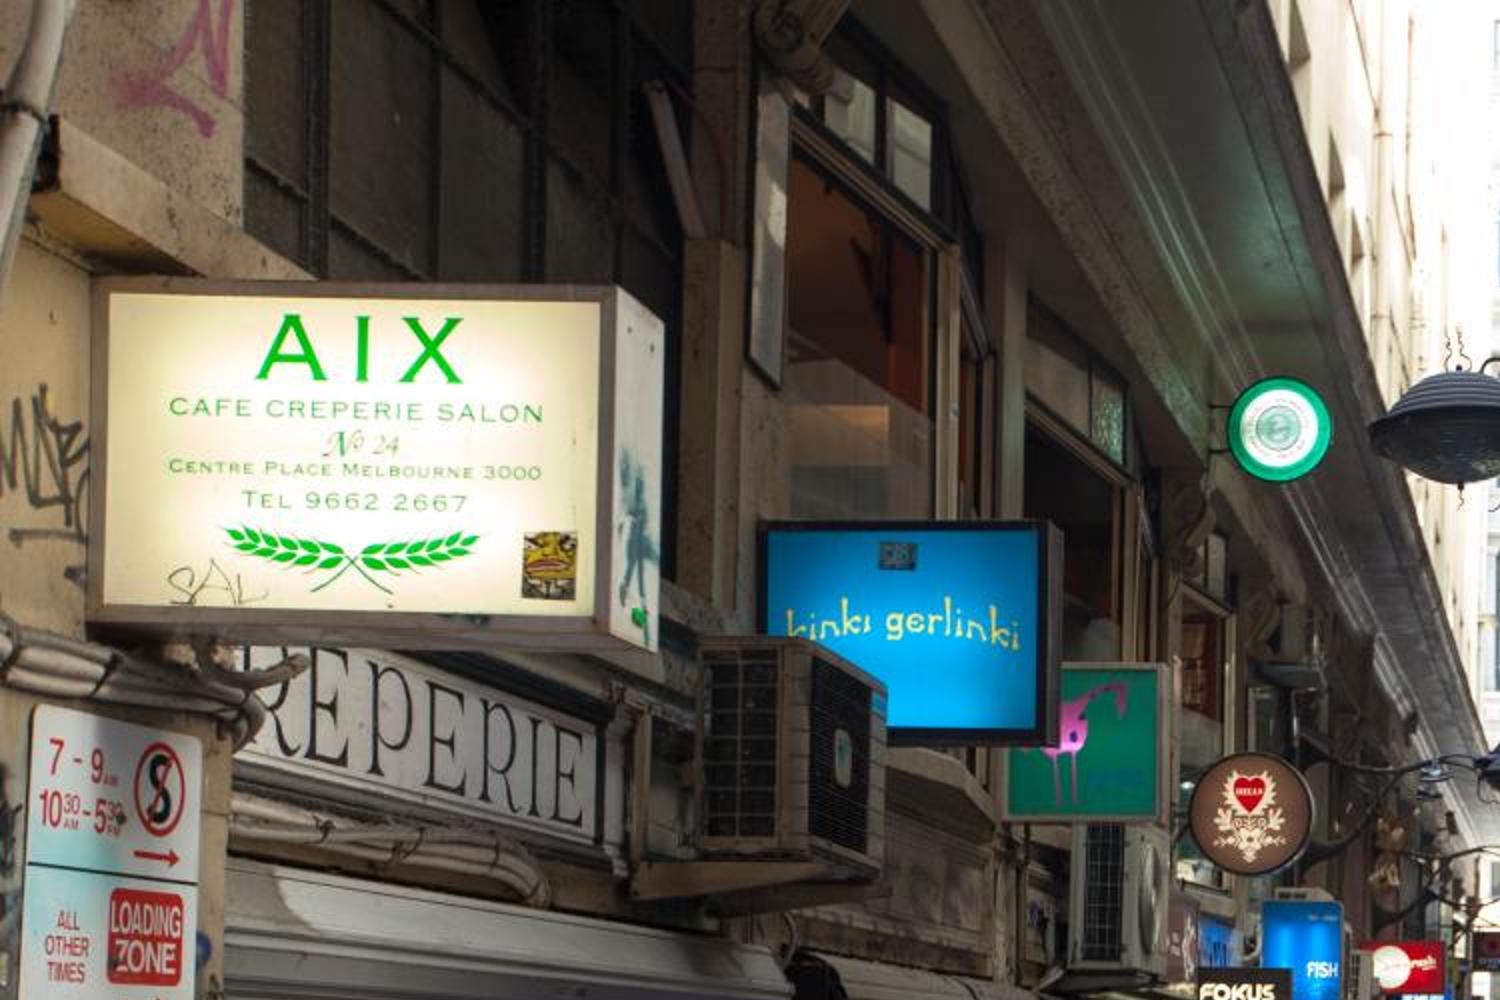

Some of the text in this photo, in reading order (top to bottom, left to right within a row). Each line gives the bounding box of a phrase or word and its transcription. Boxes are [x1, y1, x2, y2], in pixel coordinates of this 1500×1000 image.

[255, 313, 464, 385] AIX
[168, 396, 544, 424] CAFE CREPERIE SALON
[372, 434, 400, 457] 24
[483, 465, 543, 481] 3000
[305, 491, 380, 512] 9662
[393, 494, 468, 513] 2667
[886, 595, 1021, 651] gerlinki
[57, 909, 81, 931] ALL
[111, 899, 182, 939] LOADING
[44, 934, 90, 957] OTHER
[115, 938, 177, 976] ZONE
[47, 960, 86, 984] TIMES
[1306, 961, 1339, 979] FISH
